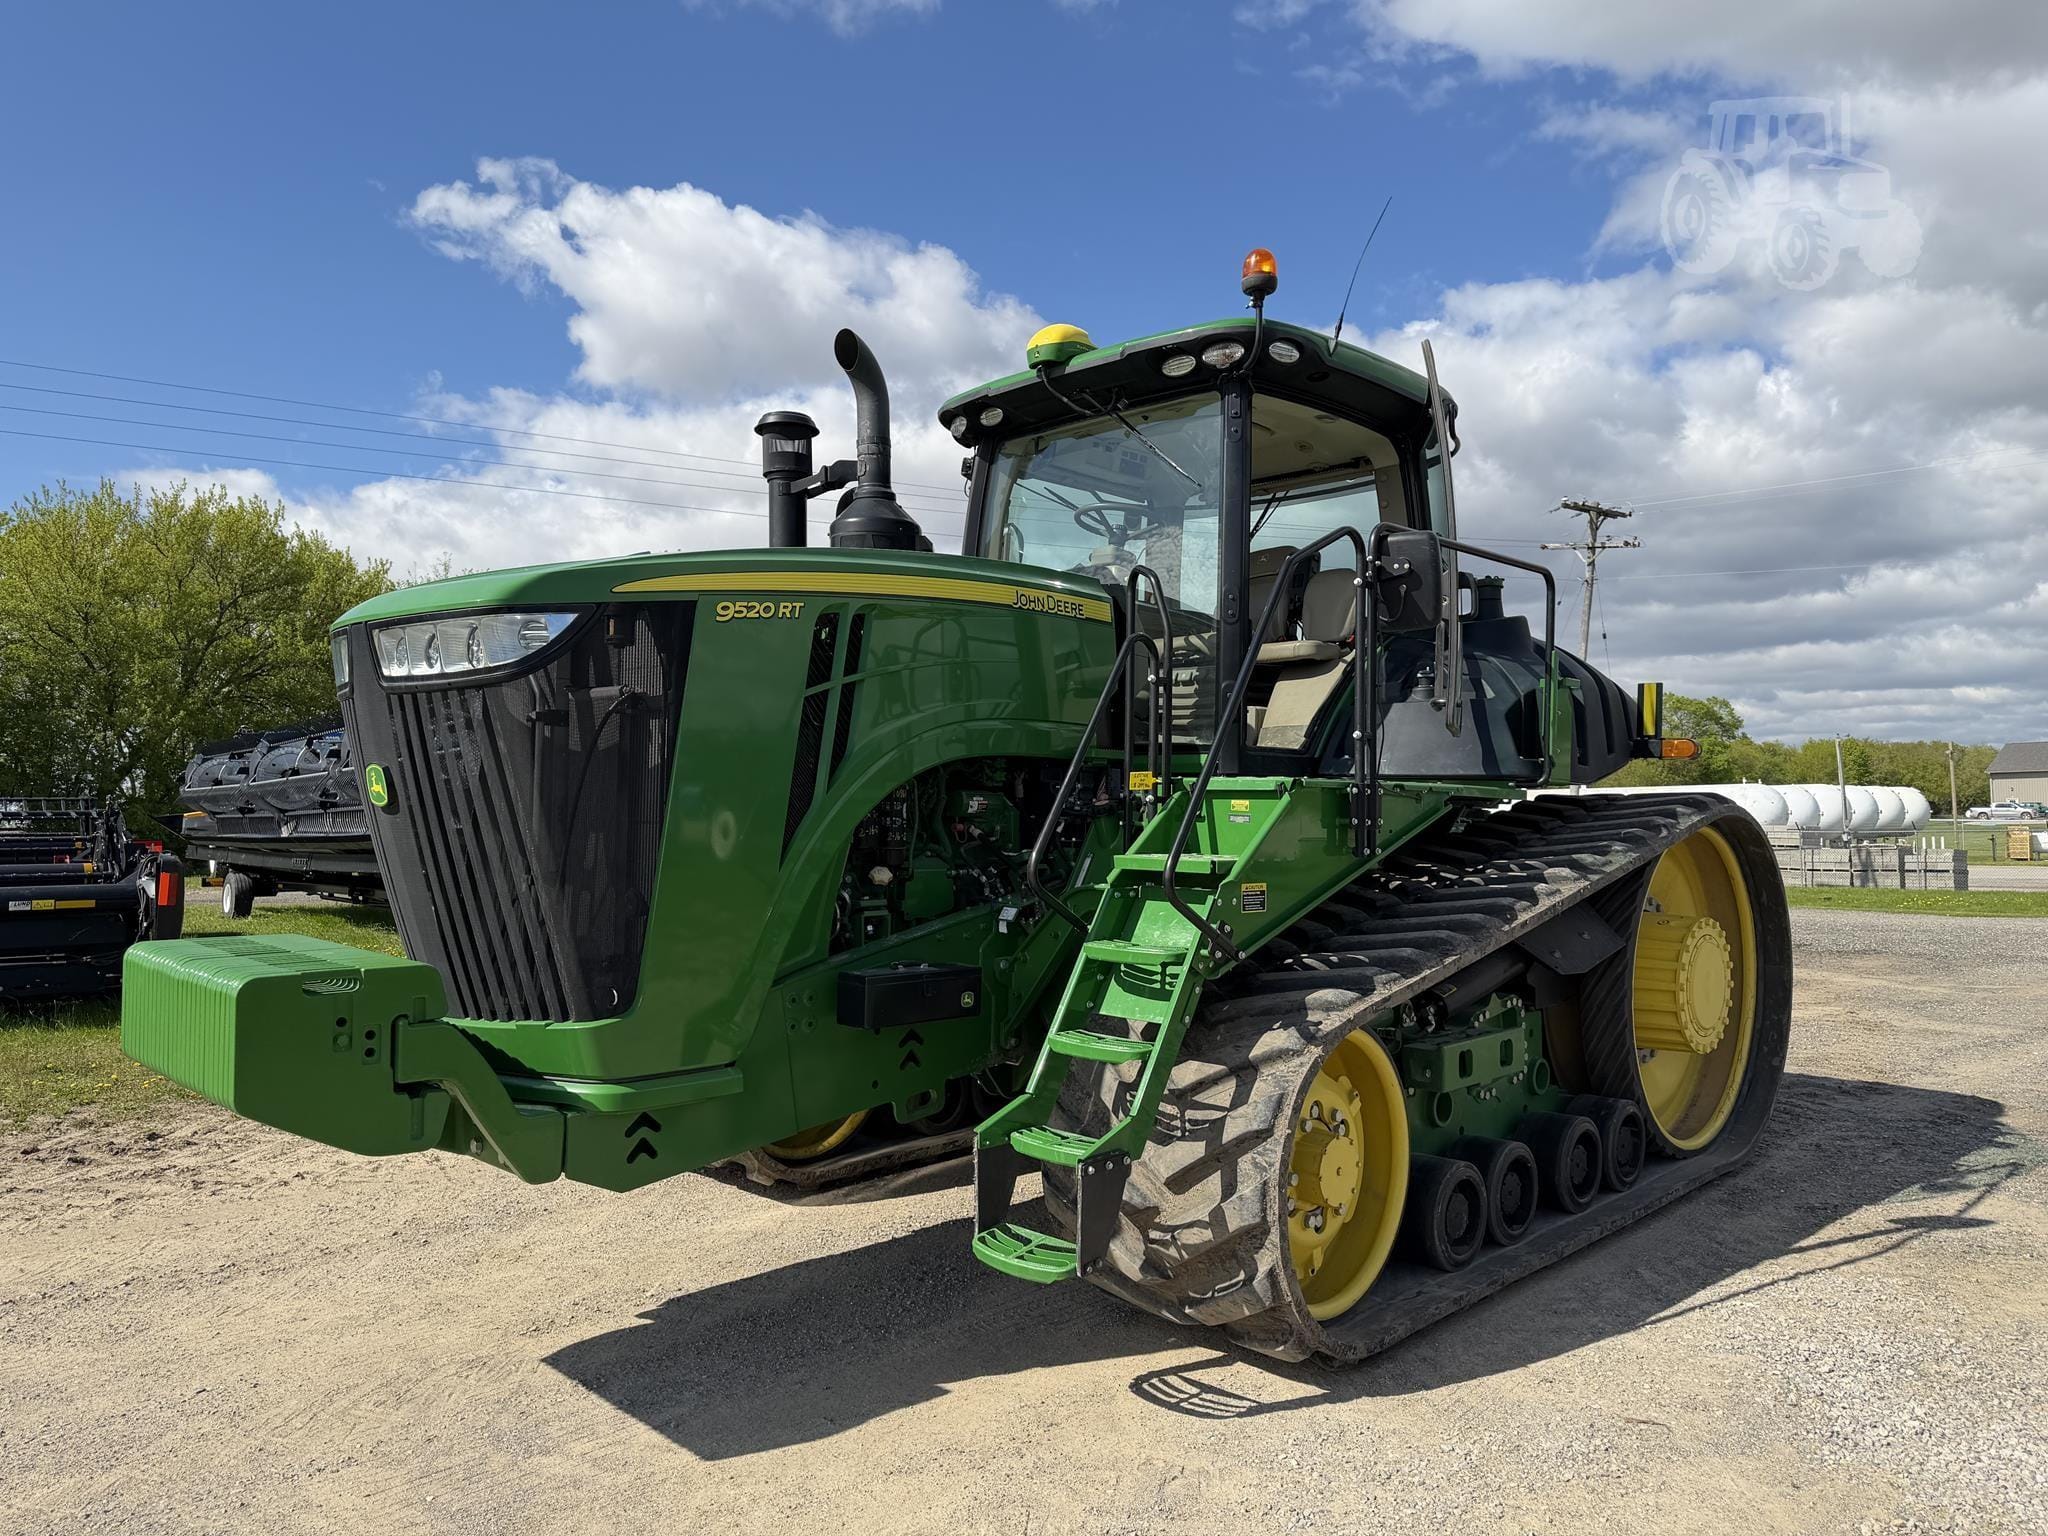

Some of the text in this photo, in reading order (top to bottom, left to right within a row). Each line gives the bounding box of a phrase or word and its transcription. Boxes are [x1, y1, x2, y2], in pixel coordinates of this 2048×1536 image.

[715, 601, 805, 622] 9520 RT
[1012, 589, 1086, 618] JOHN DEERE
